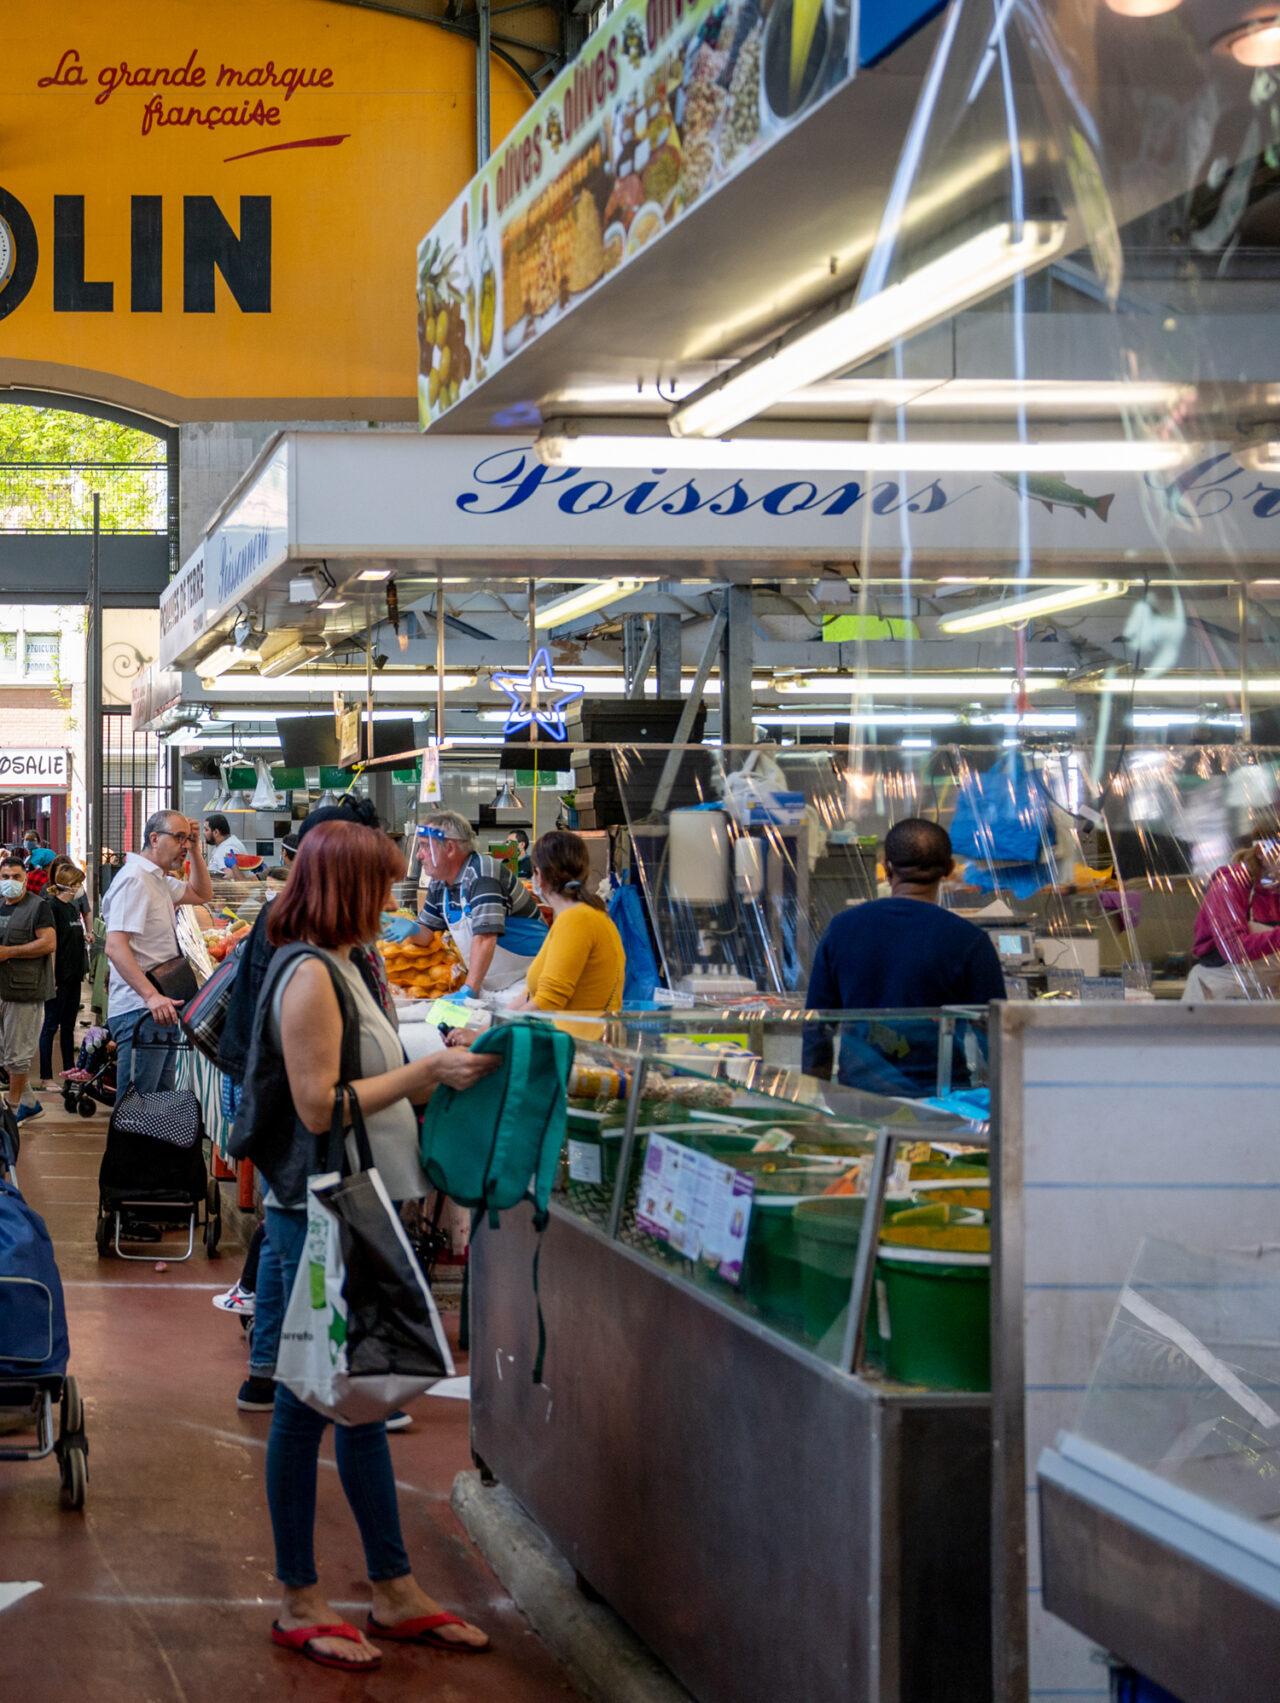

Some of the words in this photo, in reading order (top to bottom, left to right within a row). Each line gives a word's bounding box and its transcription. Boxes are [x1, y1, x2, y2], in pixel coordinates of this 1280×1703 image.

[37, 49, 88, 88] La
[97, 49, 207, 104] grande
[216, 61, 335, 102] marque
[564, 34, 618, 143] olives
[141, 95, 281, 136] française
[495, 124, 543, 214] olives
[456, 446, 982, 519] Poissons
